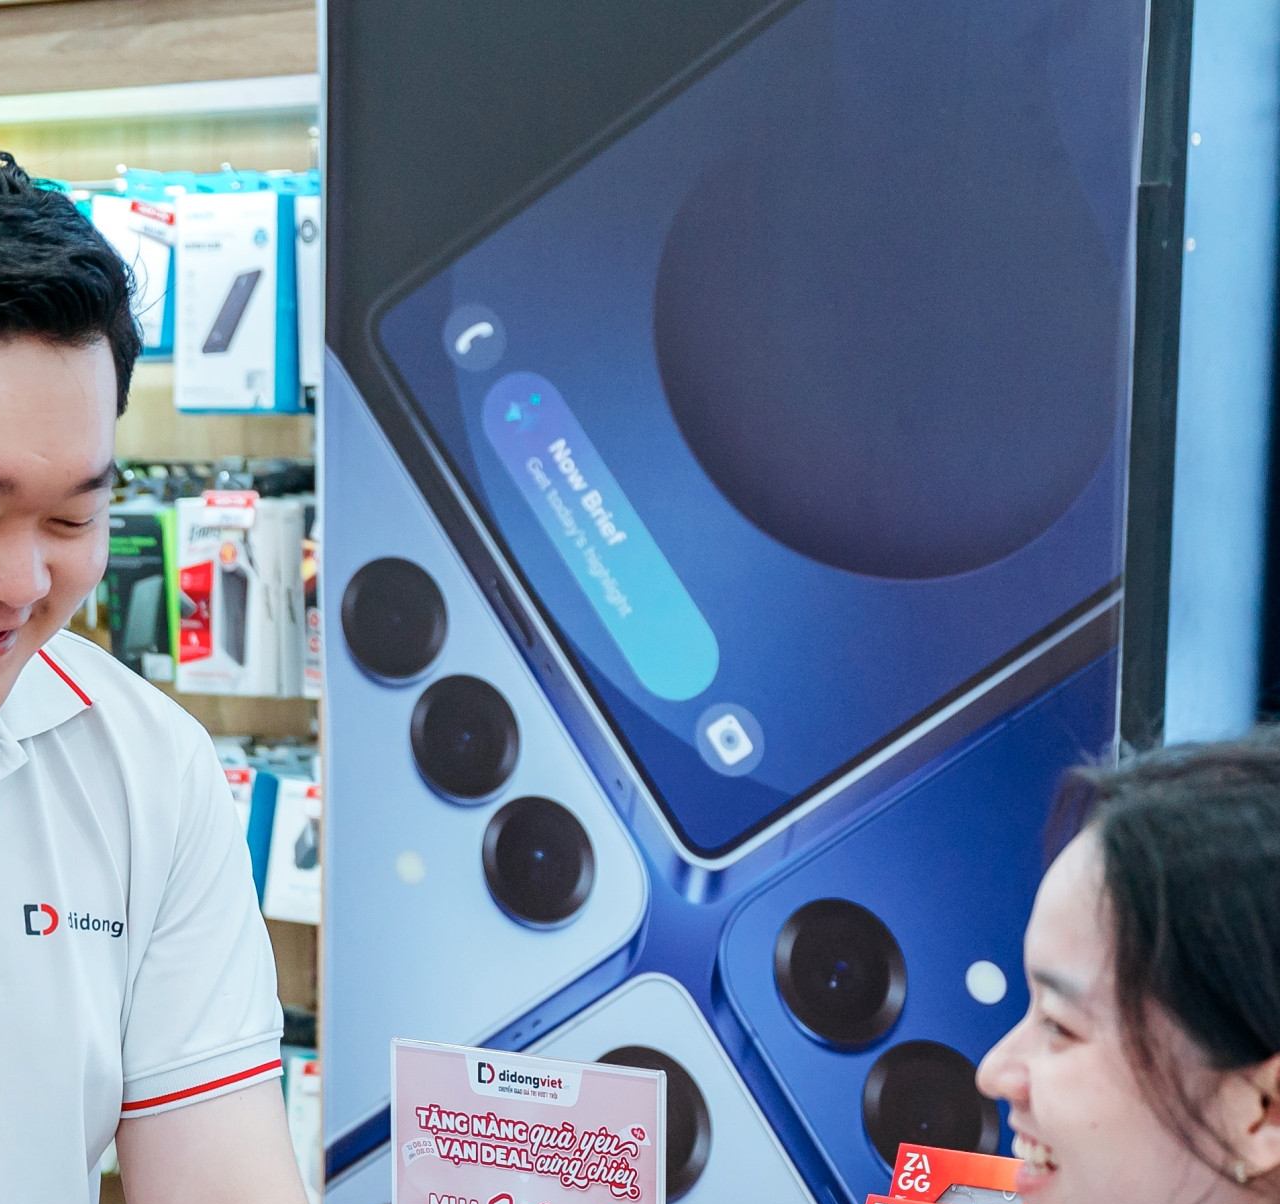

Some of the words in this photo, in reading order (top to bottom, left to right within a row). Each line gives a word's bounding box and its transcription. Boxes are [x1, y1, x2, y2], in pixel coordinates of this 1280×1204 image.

[526, 457, 552, 491] Get
[548, 438, 588, 492] Now
[581, 489, 627, 546] Brief
[416, 1104, 469, 1135] TẶNG
[472, 1112, 528, 1144] NÀNG
[529, 1121, 577, 1156] quà
[435, 1136, 477, 1166] VẠN
[480, 1143, 532, 1172] DEAL
